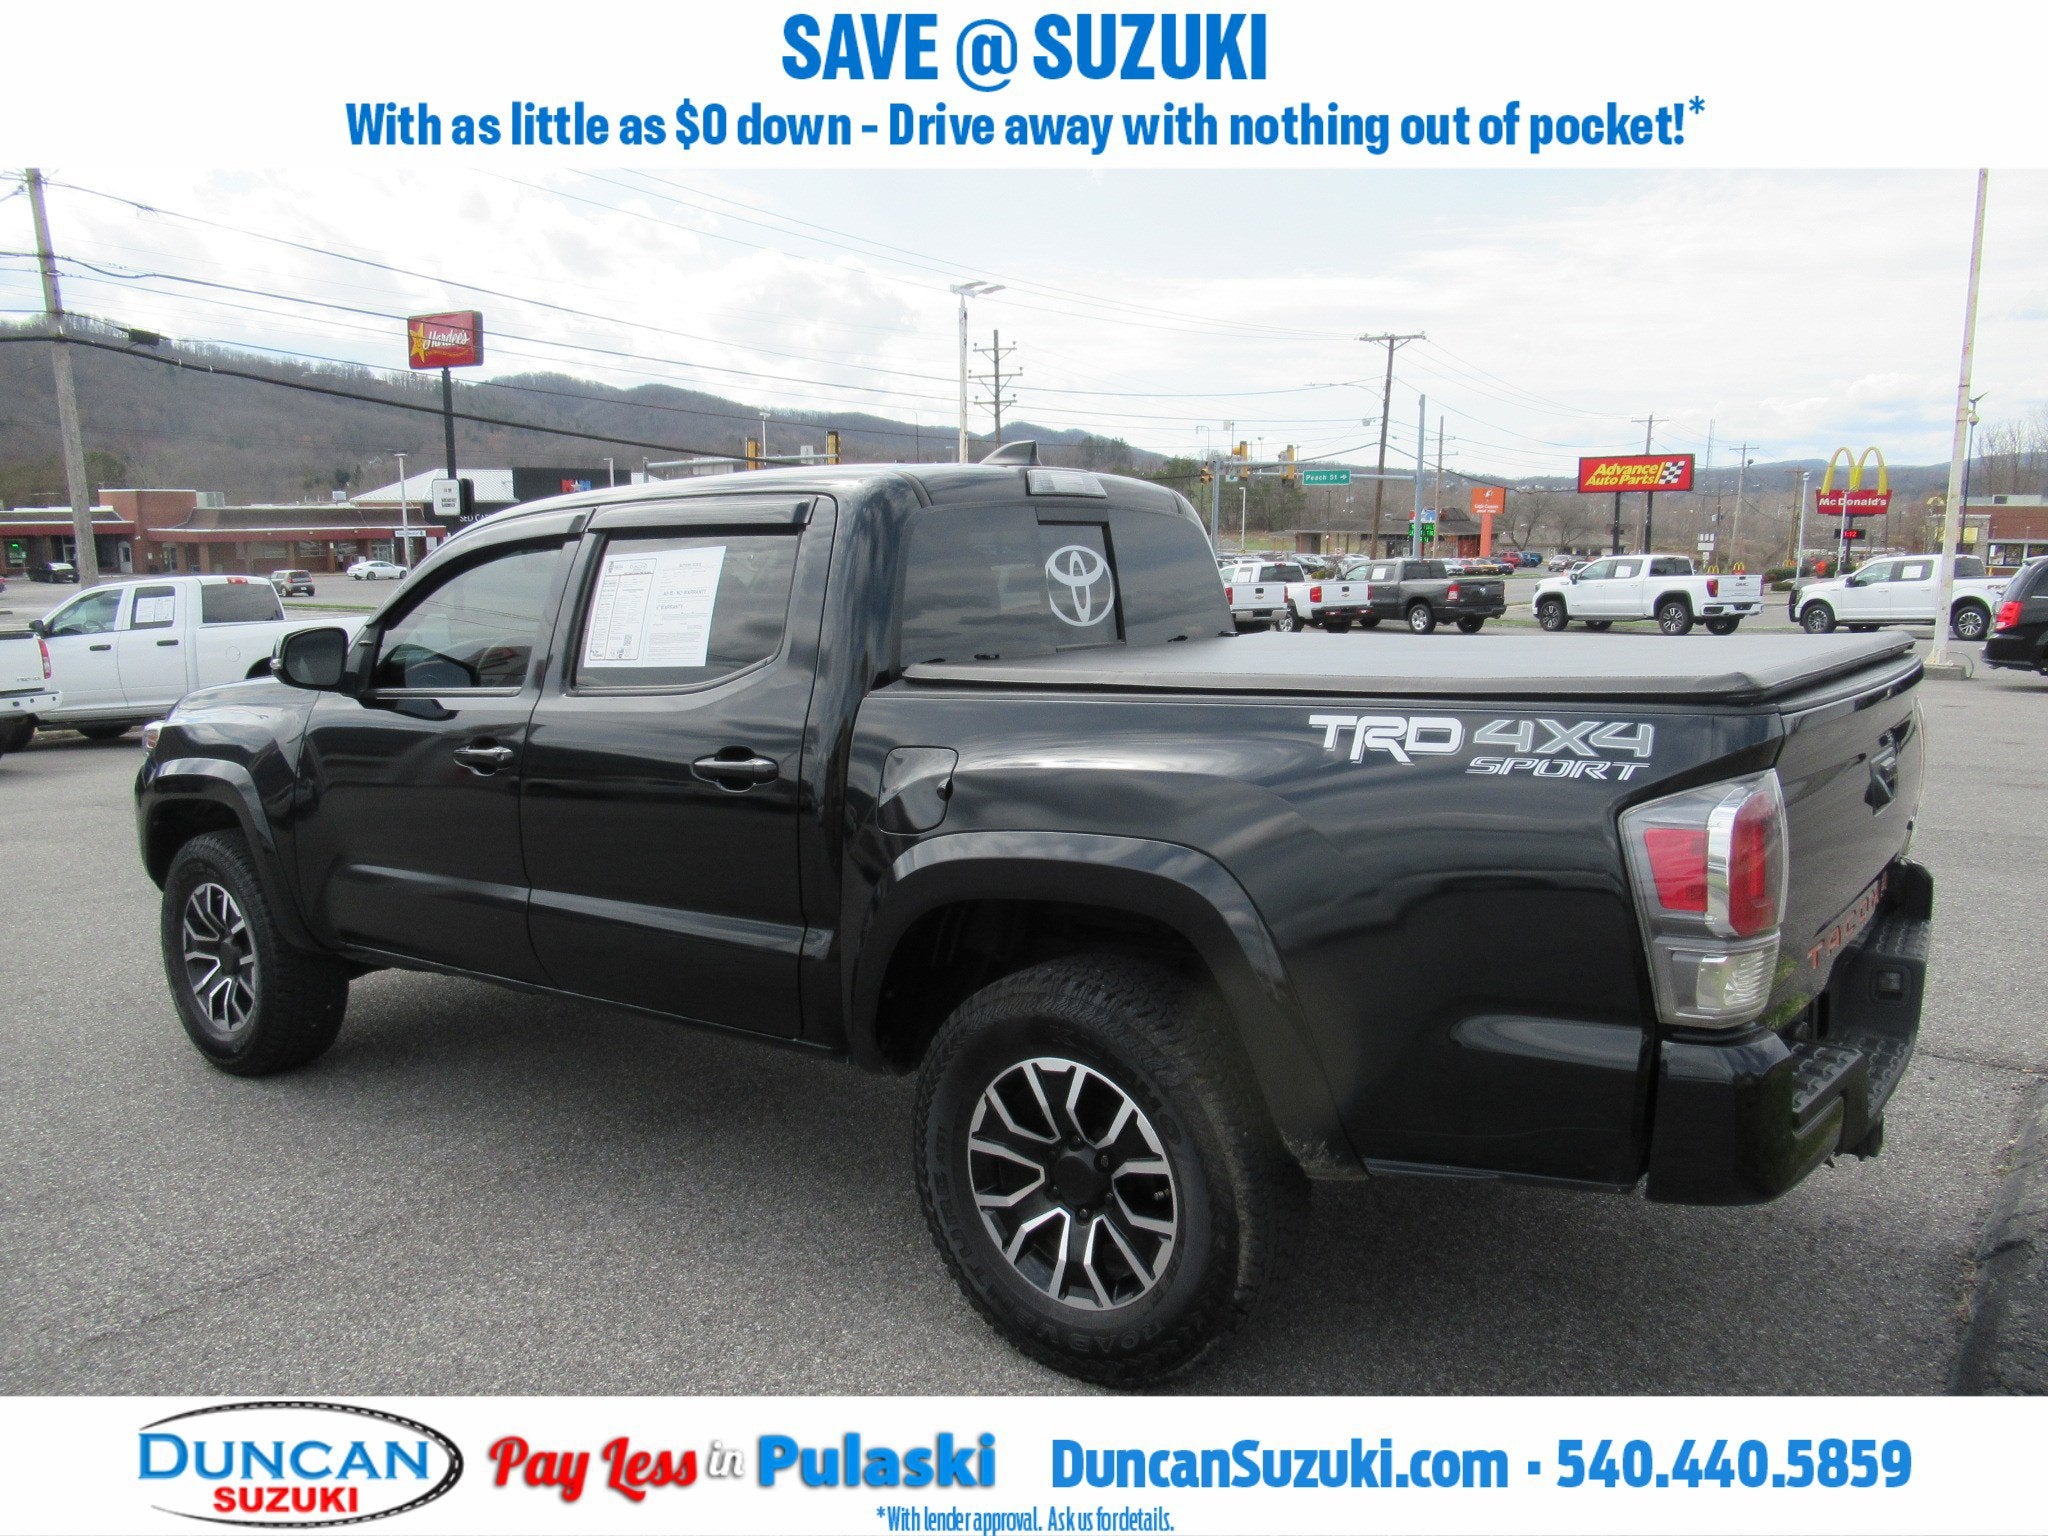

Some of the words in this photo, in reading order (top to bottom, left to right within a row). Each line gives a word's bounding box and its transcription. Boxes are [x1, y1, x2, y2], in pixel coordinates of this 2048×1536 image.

[423, 329, 470, 350] Hardee's
[1593, 463, 1658, 476] Advance
[1585, 475, 1618, 485] Auto
[1620, 474, 1655, 484] Parts
[1819, 498, 1886, 506] McDonald's
[1308, 715, 1465, 765] TRD
[1465, 756, 1650, 780] SPORT
